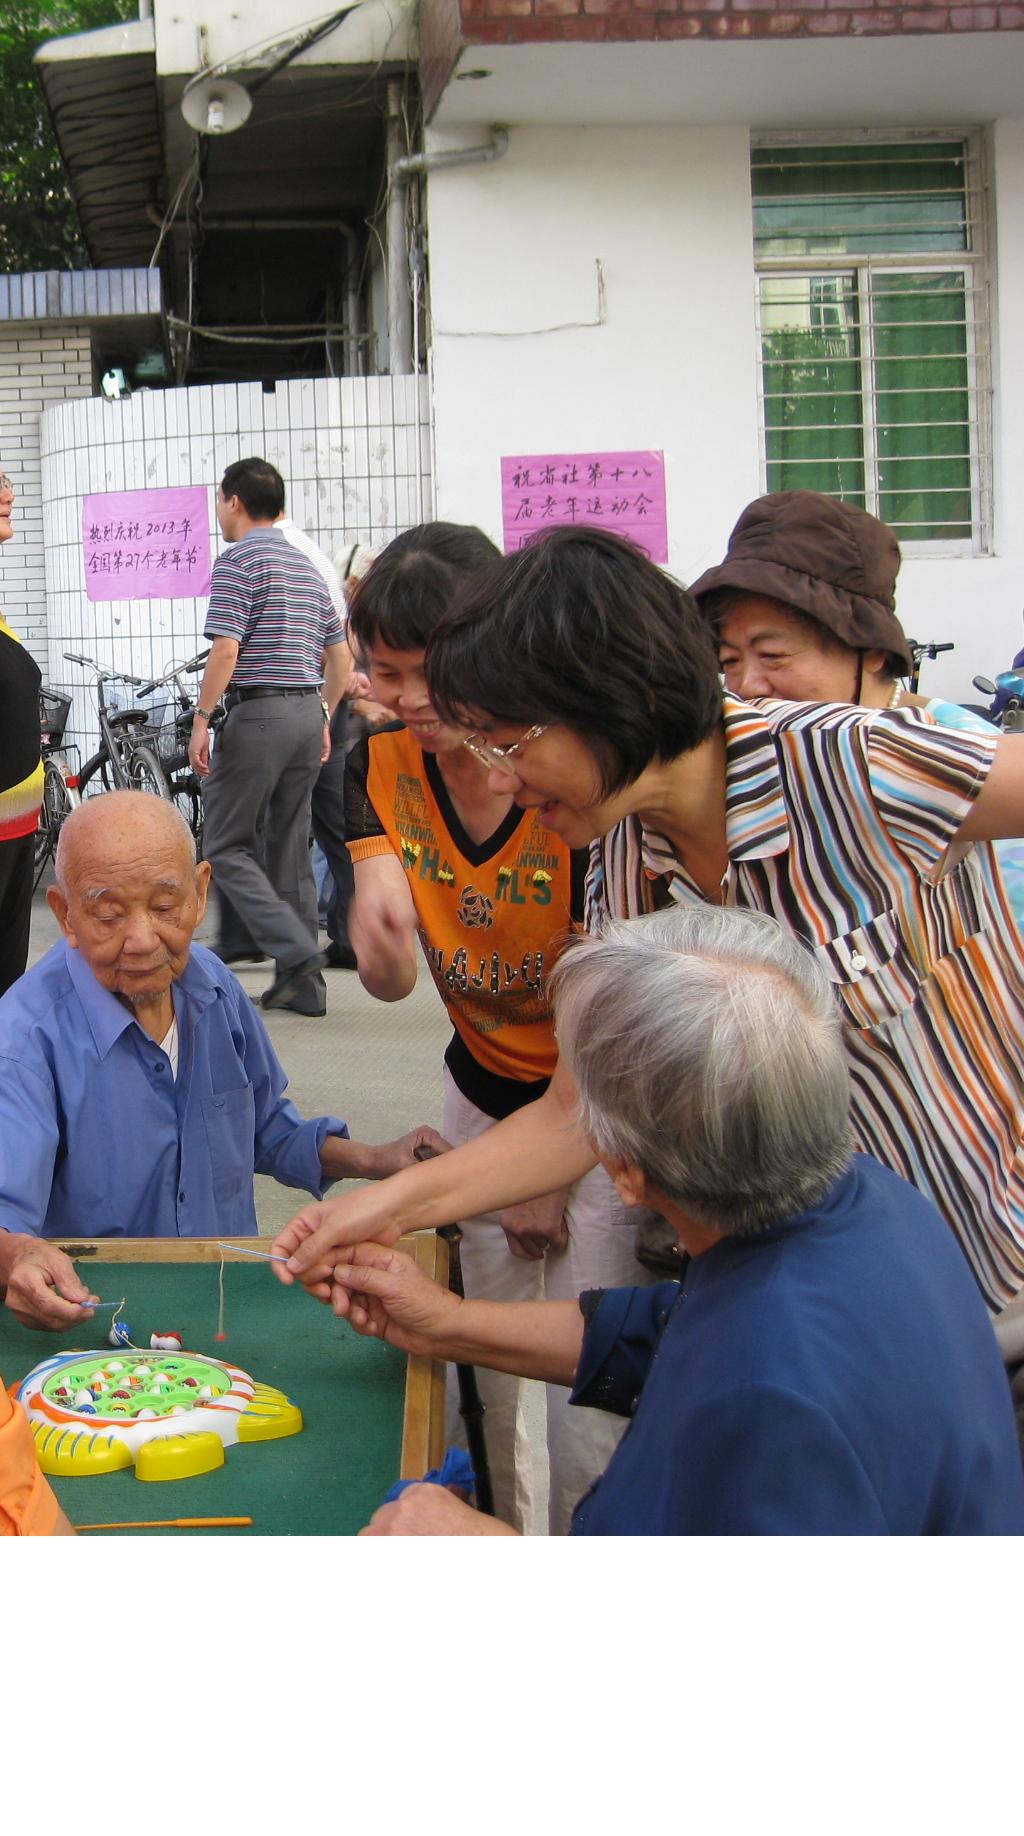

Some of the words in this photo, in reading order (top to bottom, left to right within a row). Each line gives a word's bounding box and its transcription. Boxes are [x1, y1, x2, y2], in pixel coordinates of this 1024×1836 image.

[514, 492, 654, 522] 届老年运动会
